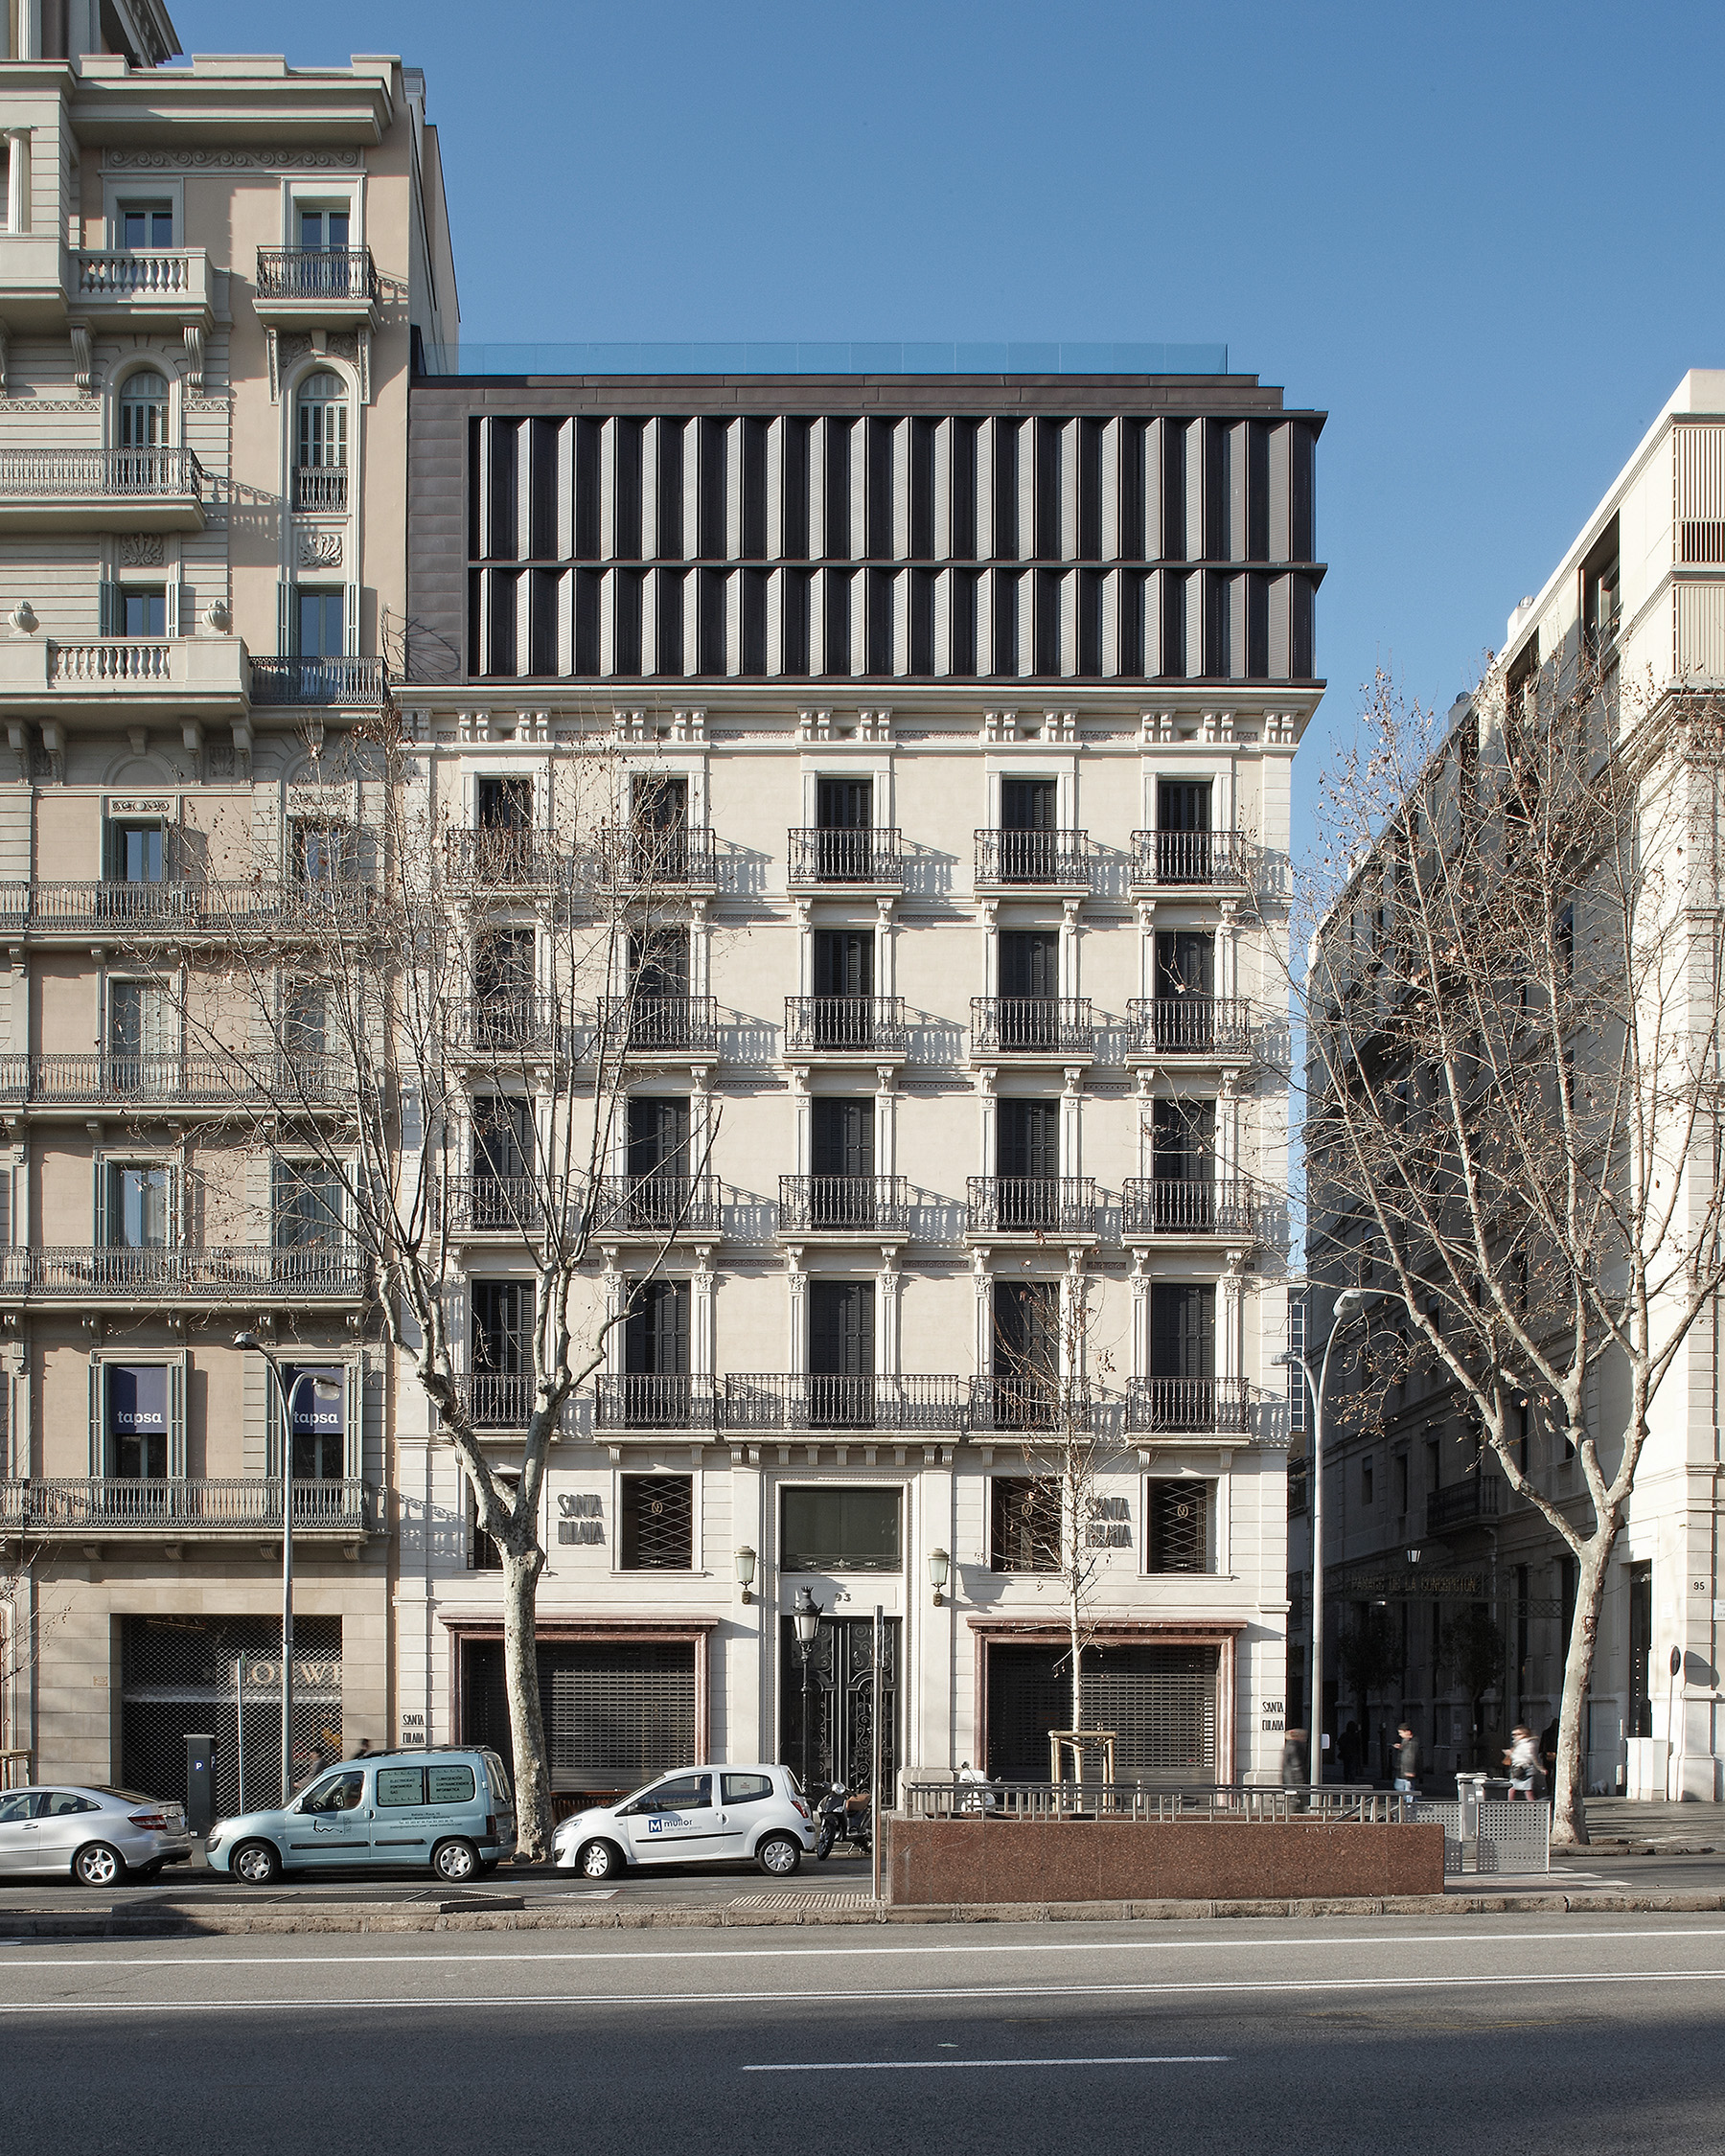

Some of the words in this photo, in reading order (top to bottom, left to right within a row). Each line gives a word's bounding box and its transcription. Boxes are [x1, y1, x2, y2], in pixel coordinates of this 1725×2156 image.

[117, 1411, 163, 1426] tapsa
[293, 1411, 339, 1427] tapsa
[557, 1494, 605, 1519] SANTA
[1085, 1497, 1132, 1522] SANTA
[1405, 1578, 1416, 1592] LA
[1693, 1581, 1705, 1591] 95
[835, 1593, 852, 1602] 93
[1262, 1701, 1284, 1712] SANTA
[402, 1714, 425, 1725] SANTA
[650, 1821, 661, 1832] M
